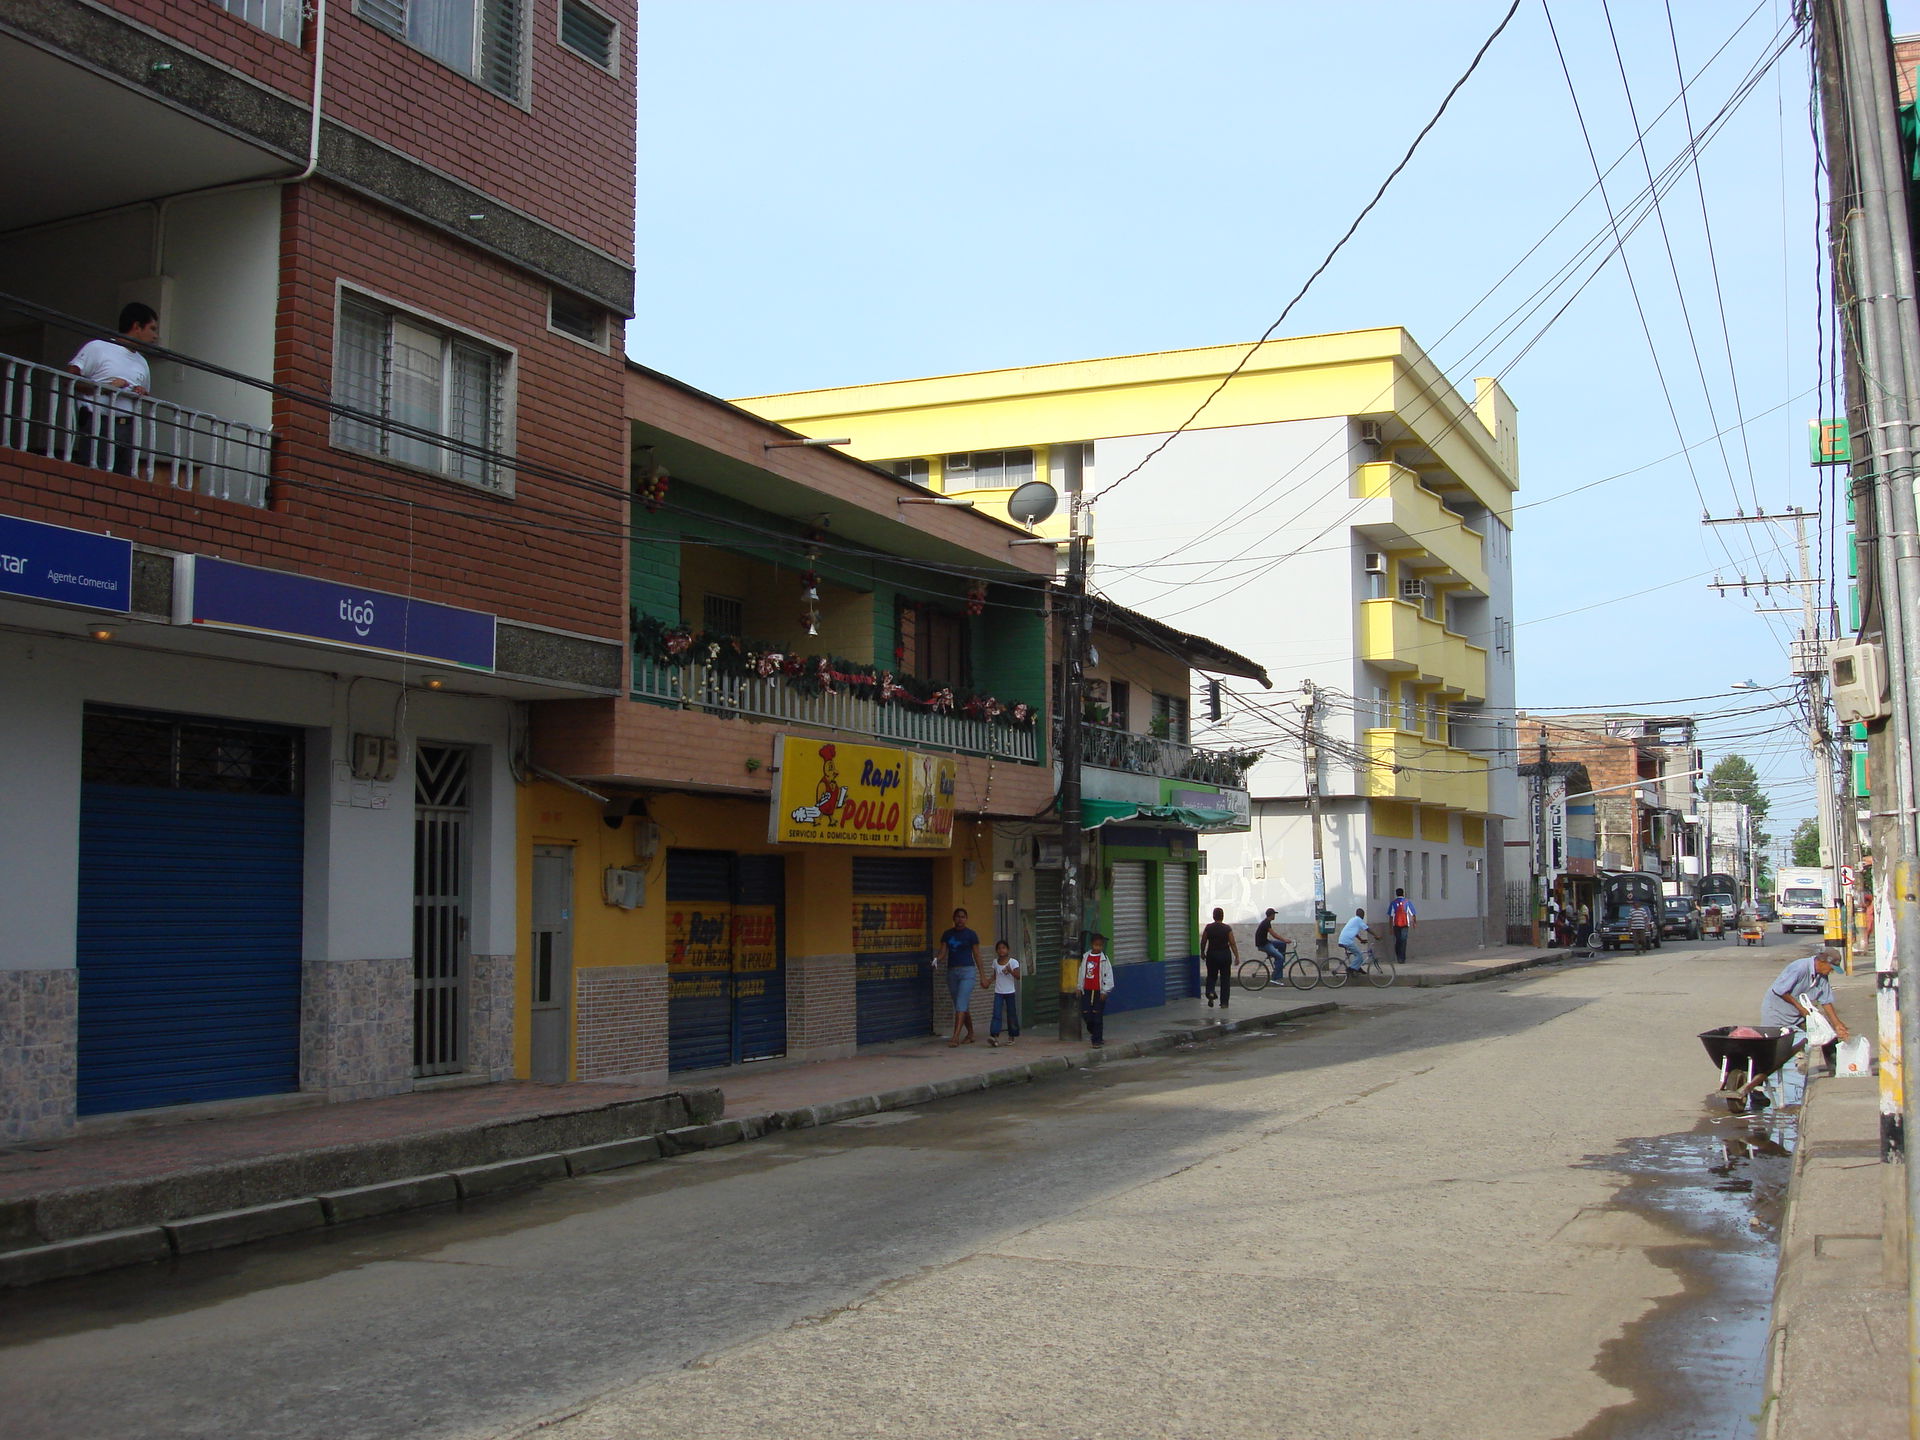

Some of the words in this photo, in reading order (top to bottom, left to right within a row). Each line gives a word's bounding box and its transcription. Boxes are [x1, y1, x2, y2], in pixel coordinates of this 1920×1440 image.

[0, 554, 28, 575] tar
[47, 569, 77, 585] Agente
[78, 575, 118, 591] Comercial
[860, 759, 901, 797] Rapi
[840, 799, 900, 832] POLLO
[788, 829, 817, 839] SERVICIO
[827, 832, 857, 841] DOMICILIO
